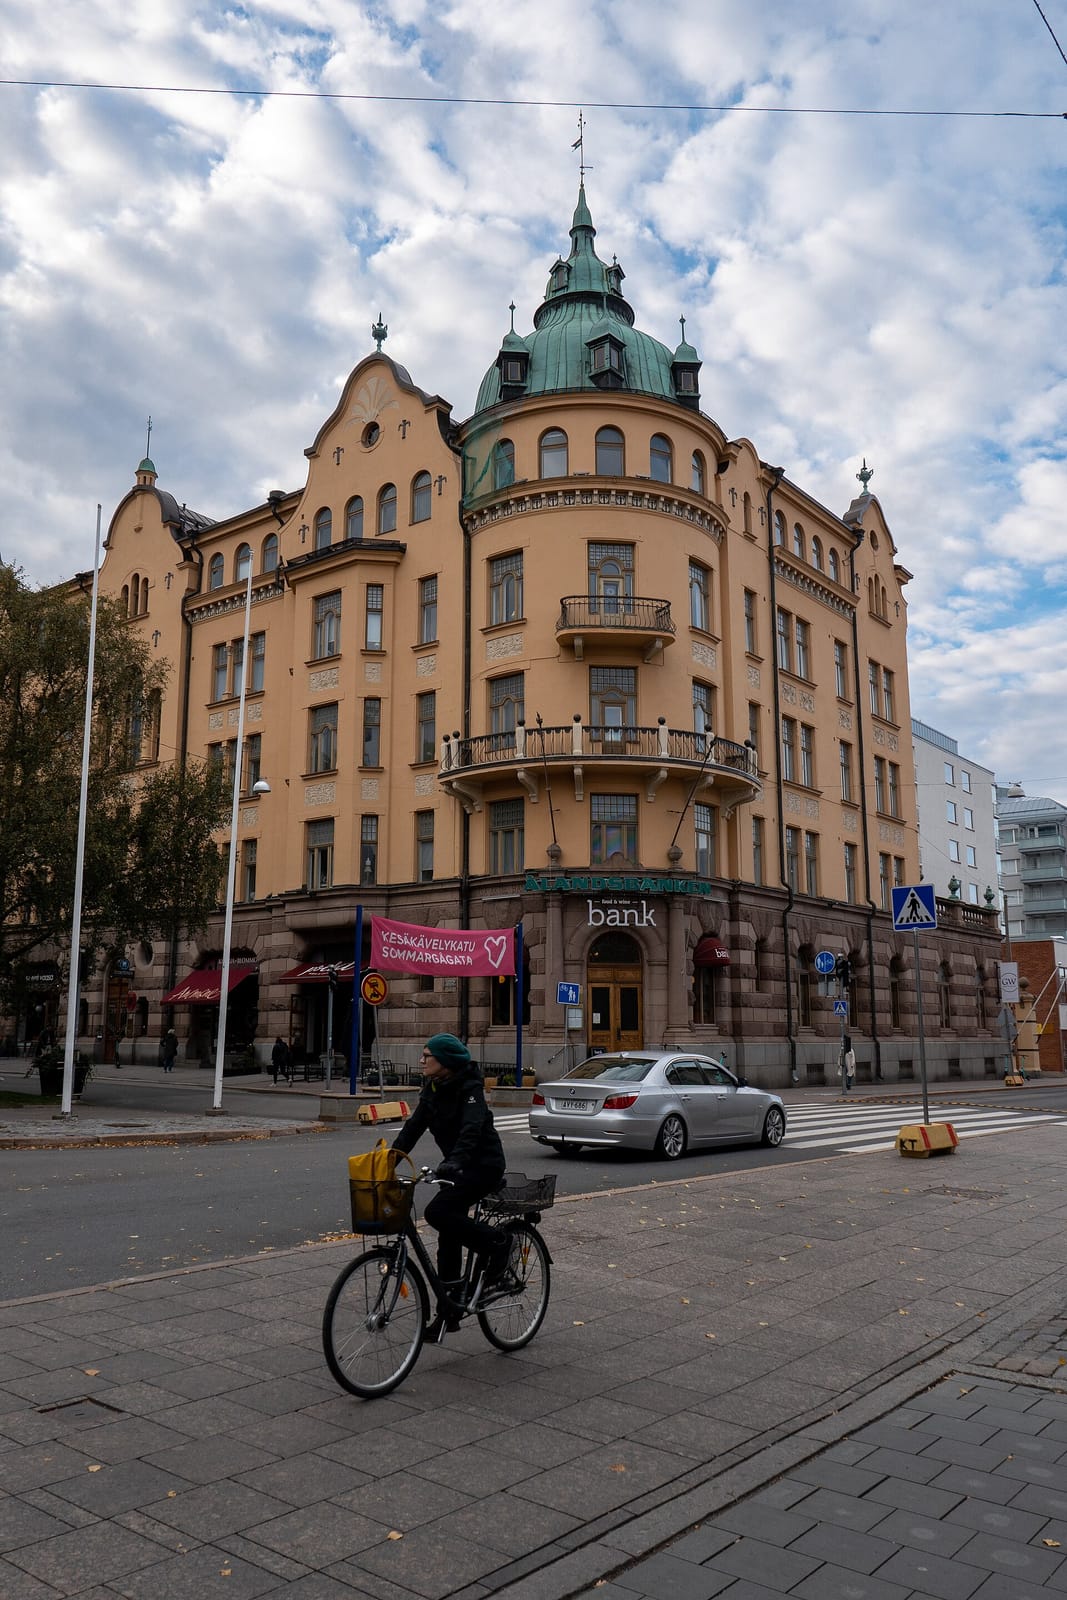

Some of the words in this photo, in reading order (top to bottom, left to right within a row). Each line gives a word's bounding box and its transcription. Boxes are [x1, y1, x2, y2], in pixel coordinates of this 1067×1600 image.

[524, 875, 712, 894] ÅLANDSBANKEN
[586, 899, 657, 927] bank
[381, 930, 476, 952] KESÄKÄVELYKATU
[381, 946, 473, 966] SOMMARGÅGATA
[1001, 978, 1017, 986] GW
[899, 1138, 917, 1152] KT
